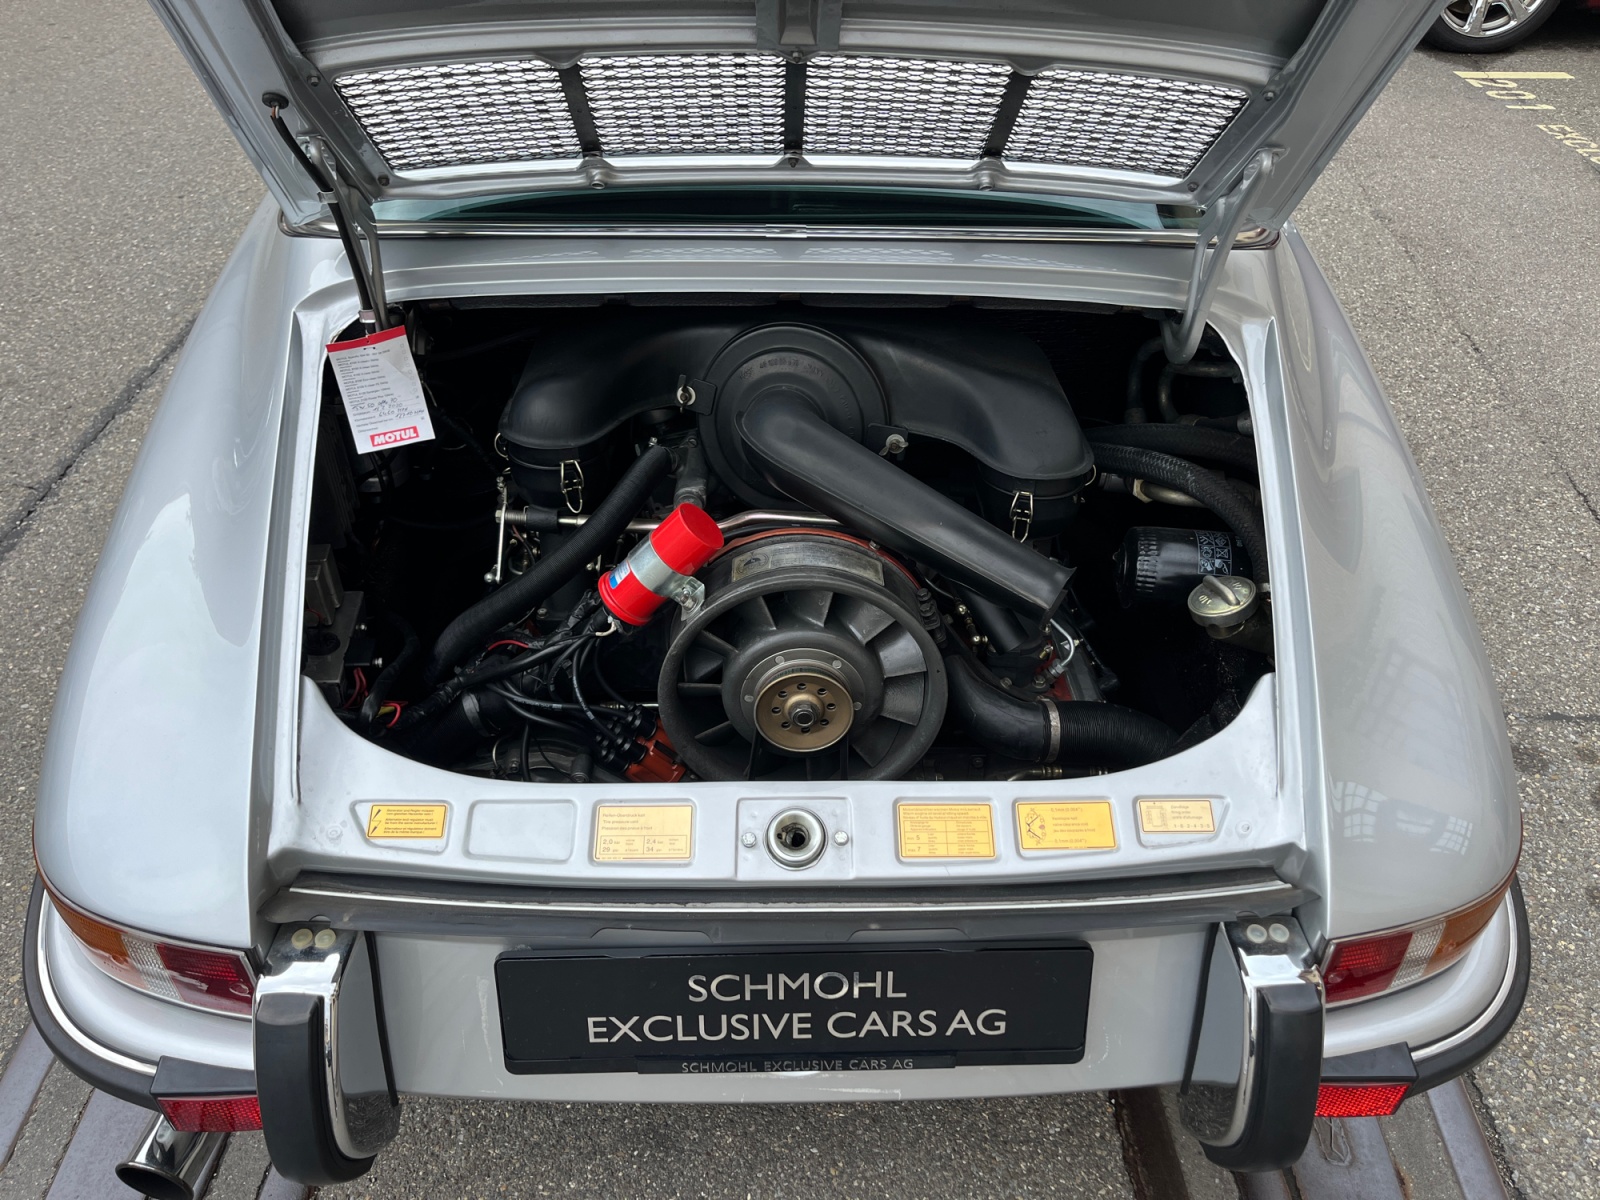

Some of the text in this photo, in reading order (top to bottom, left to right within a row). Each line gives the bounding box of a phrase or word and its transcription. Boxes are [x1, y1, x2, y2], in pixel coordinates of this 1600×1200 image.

[374, 428, 416, 445] MOTUL
[688, 971, 907, 1002] SCHMOHL
[587, 1009, 1007, 1043] EXCLUSIVE CARS AG
[681, 1059, 914, 1073] SCHMOHL EXCLUSIVE CARS AG
